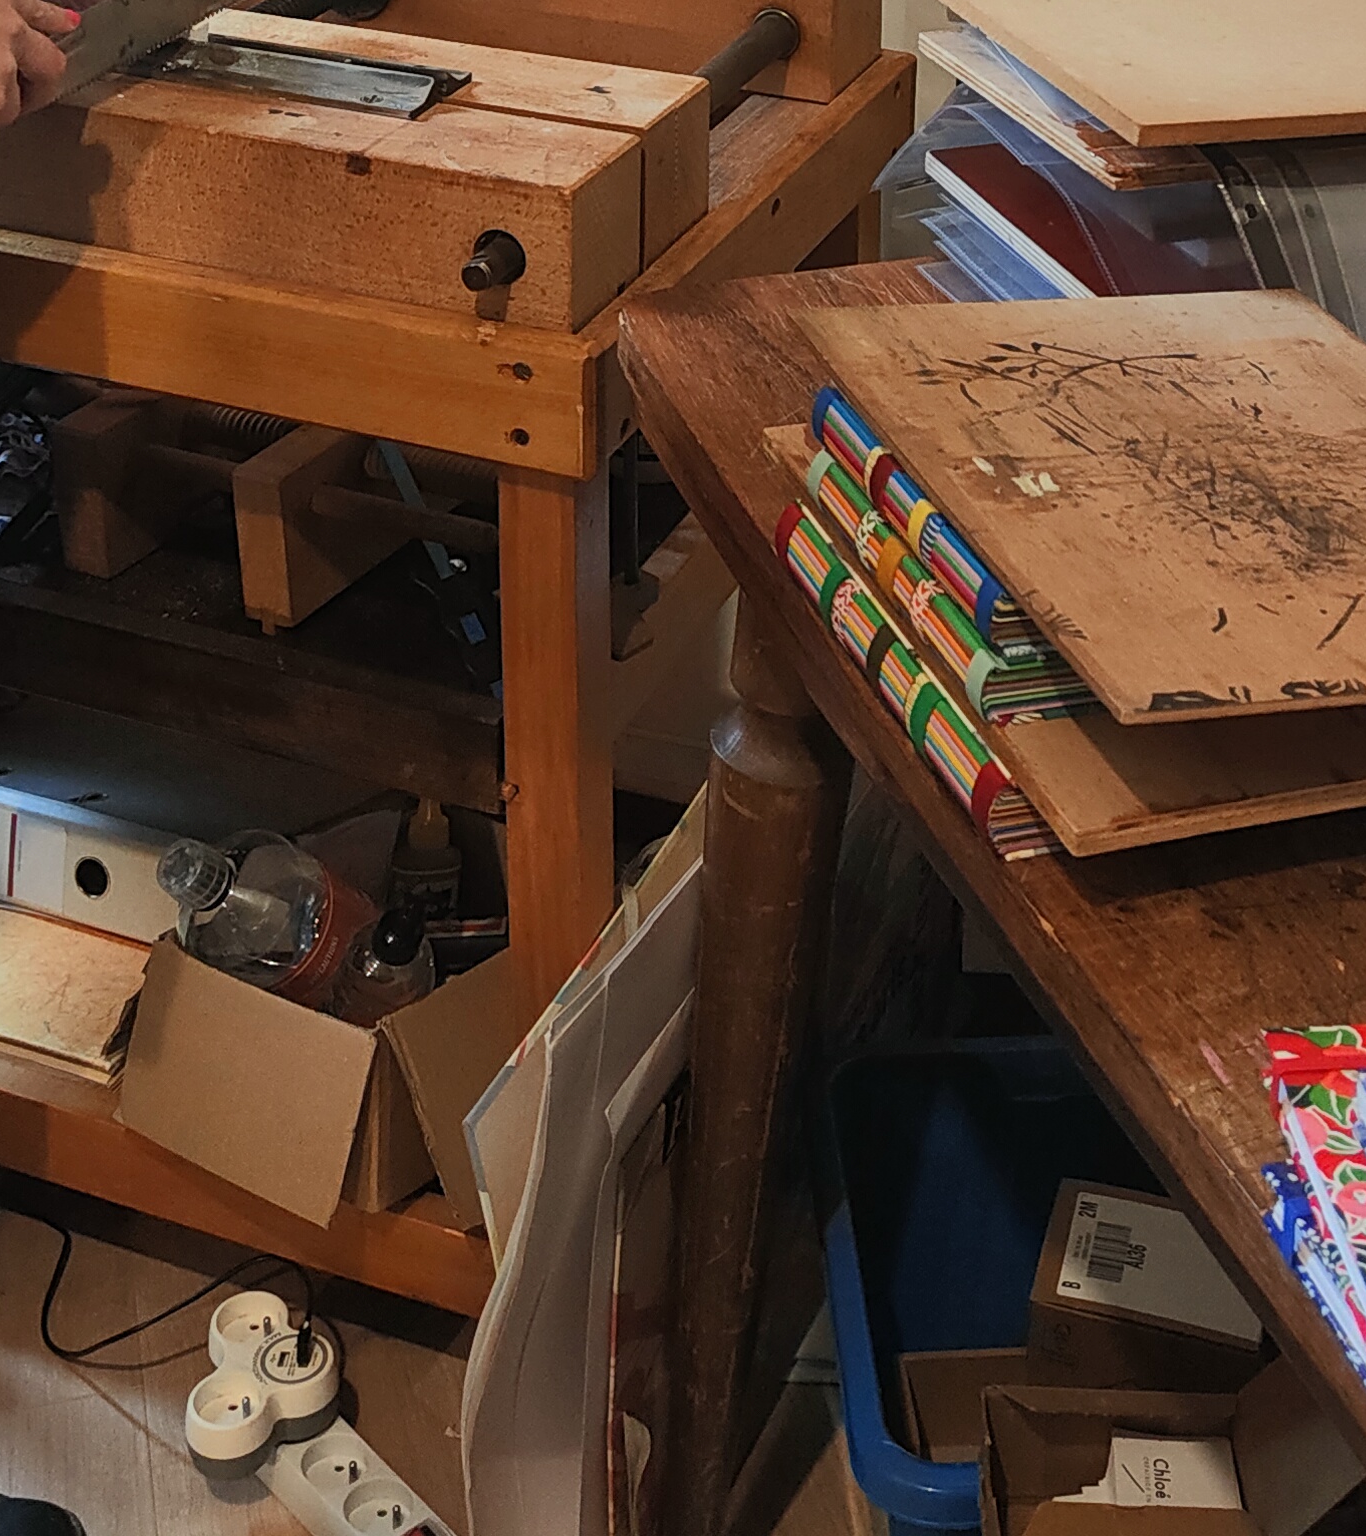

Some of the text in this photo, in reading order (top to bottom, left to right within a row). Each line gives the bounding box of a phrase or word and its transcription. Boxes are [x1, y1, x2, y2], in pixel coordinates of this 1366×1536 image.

[1078, 1201, 1099, 1219] 2M
[1061, 1281, 1081, 1290] B
[1153, 1458, 1172, 1498] Chloé
